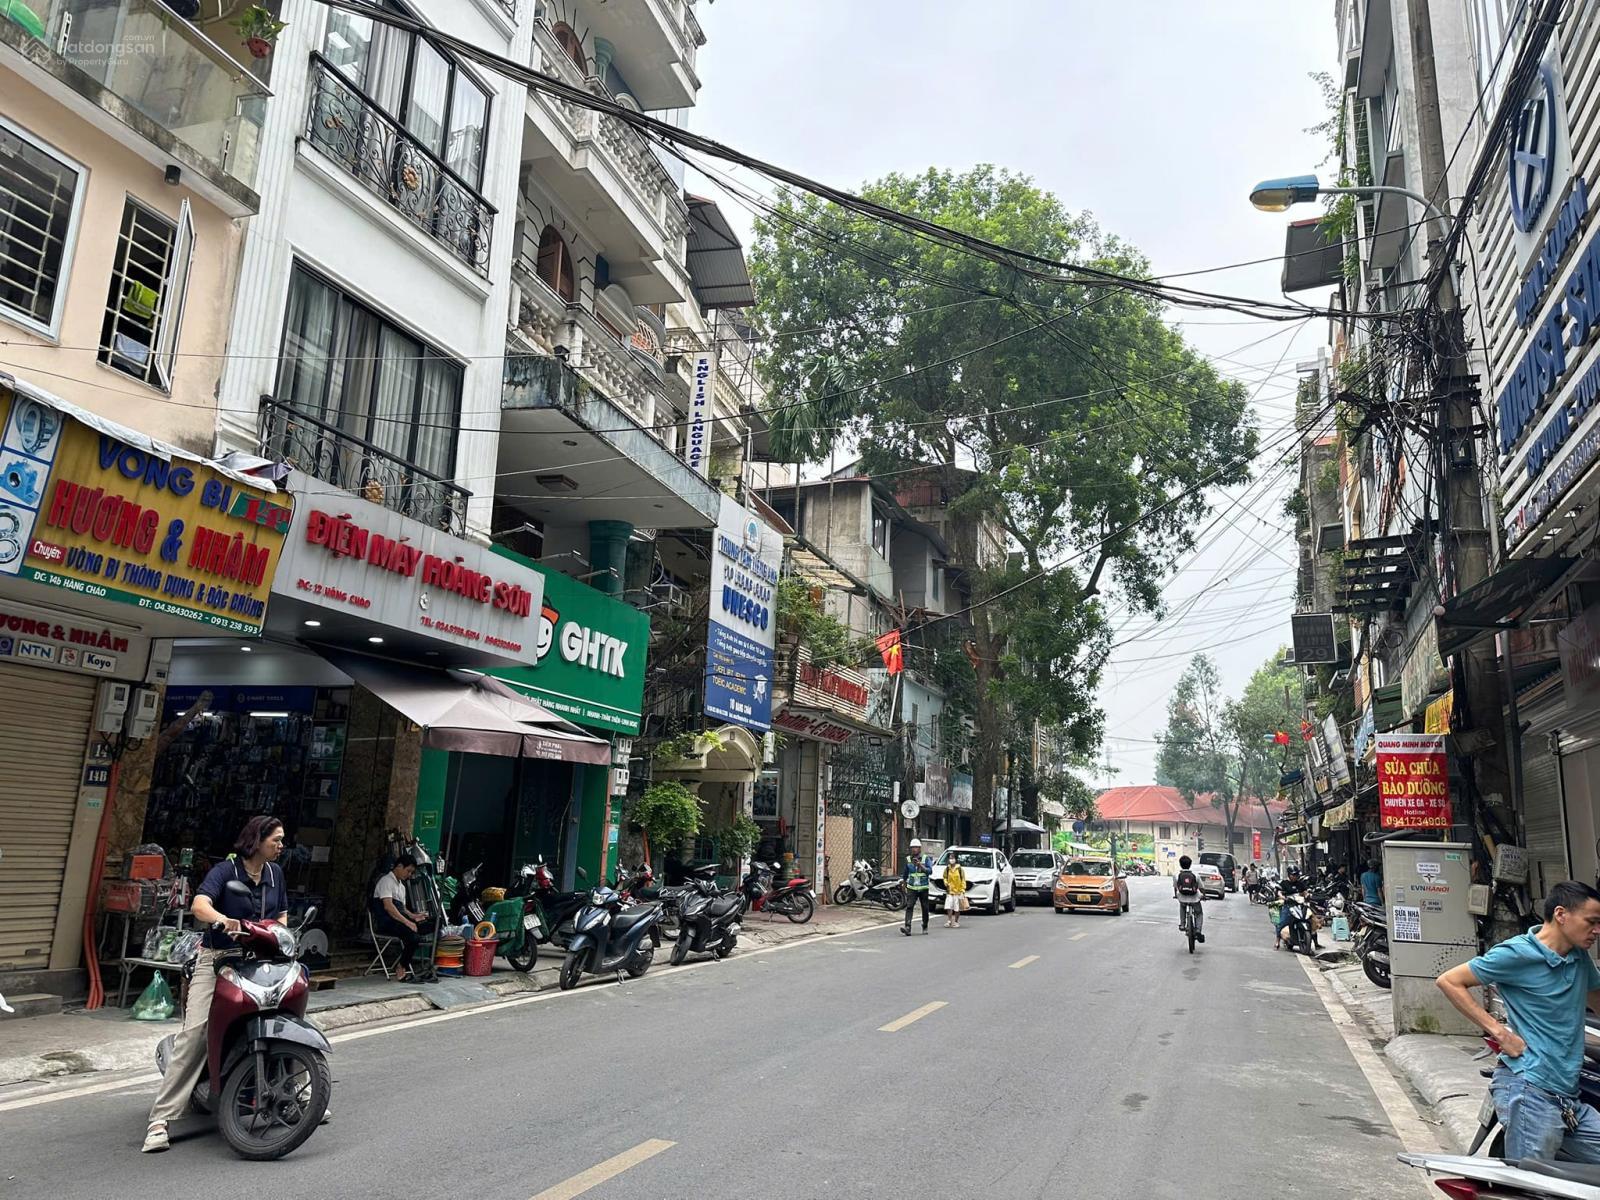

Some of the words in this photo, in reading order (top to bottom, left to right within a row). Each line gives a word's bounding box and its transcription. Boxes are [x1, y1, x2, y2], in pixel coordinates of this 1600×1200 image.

[694, 358, 709, 407] ENGLISH
[690, 411, 704, 468] LANGUAGE
[201, 478, 233, 512] BI
[48, 478, 160, 555] HƯƠNG
[161, 518, 184, 562] &
[188, 525, 270, 587] NHÂM
[306, 508, 369, 560] ĐIỆN
[367, 534, 423, 578] MÁY
[493, 580, 532, 618] SƠN
[34, 572, 47, 581] ĐC:
[49, 575, 61, 585] 14b
[63, 578, 84, 592] HÀNG
[67, 545, 103, 575] VÒNG
[122, 563, 162, 591] THÔNG
[163, 574, 195, 598] DỤNG
[196, 583, 206, 603] &
[314, 583, 323, 594] 12
[138, 599, 152, 608] ĐT:
[154, 602, 203, 620] 04.38430262
[210, 615, 228, 627] 0913
[229, 621, 242, 631] 238
[243, 624, 258, 634] 593
[722, 584, 769, 630] UNESCO
[51, 624, 66, 641] &
[69, 628, 129, 652] NHÂM
[21, 644, 51, 658] NTN
[559, 621, 628, 679] GHTK
[1301, 648, 1328, 661] 29
[87, 654, 111, 669] Koyo
[1378, 741, 1400, 749] QUANG
[88, 770, 108, 781] 14B
[1384, 756, 1407, 775] SỬA
[1409, 758, 1440, 775] CHỮA
[1382, 776, 1404, 795] BẢO
[1407, 778, 1446, 795] DƯỠNG
[1384, 797, 1406, 807] CHUYÊN
[1407, 797, 1415, 807] XE
[1416, 798, 1424, 807] GA
[1429, 798, 1437, 808] XE
[1386, 816, 1448, 827] 0941734908
